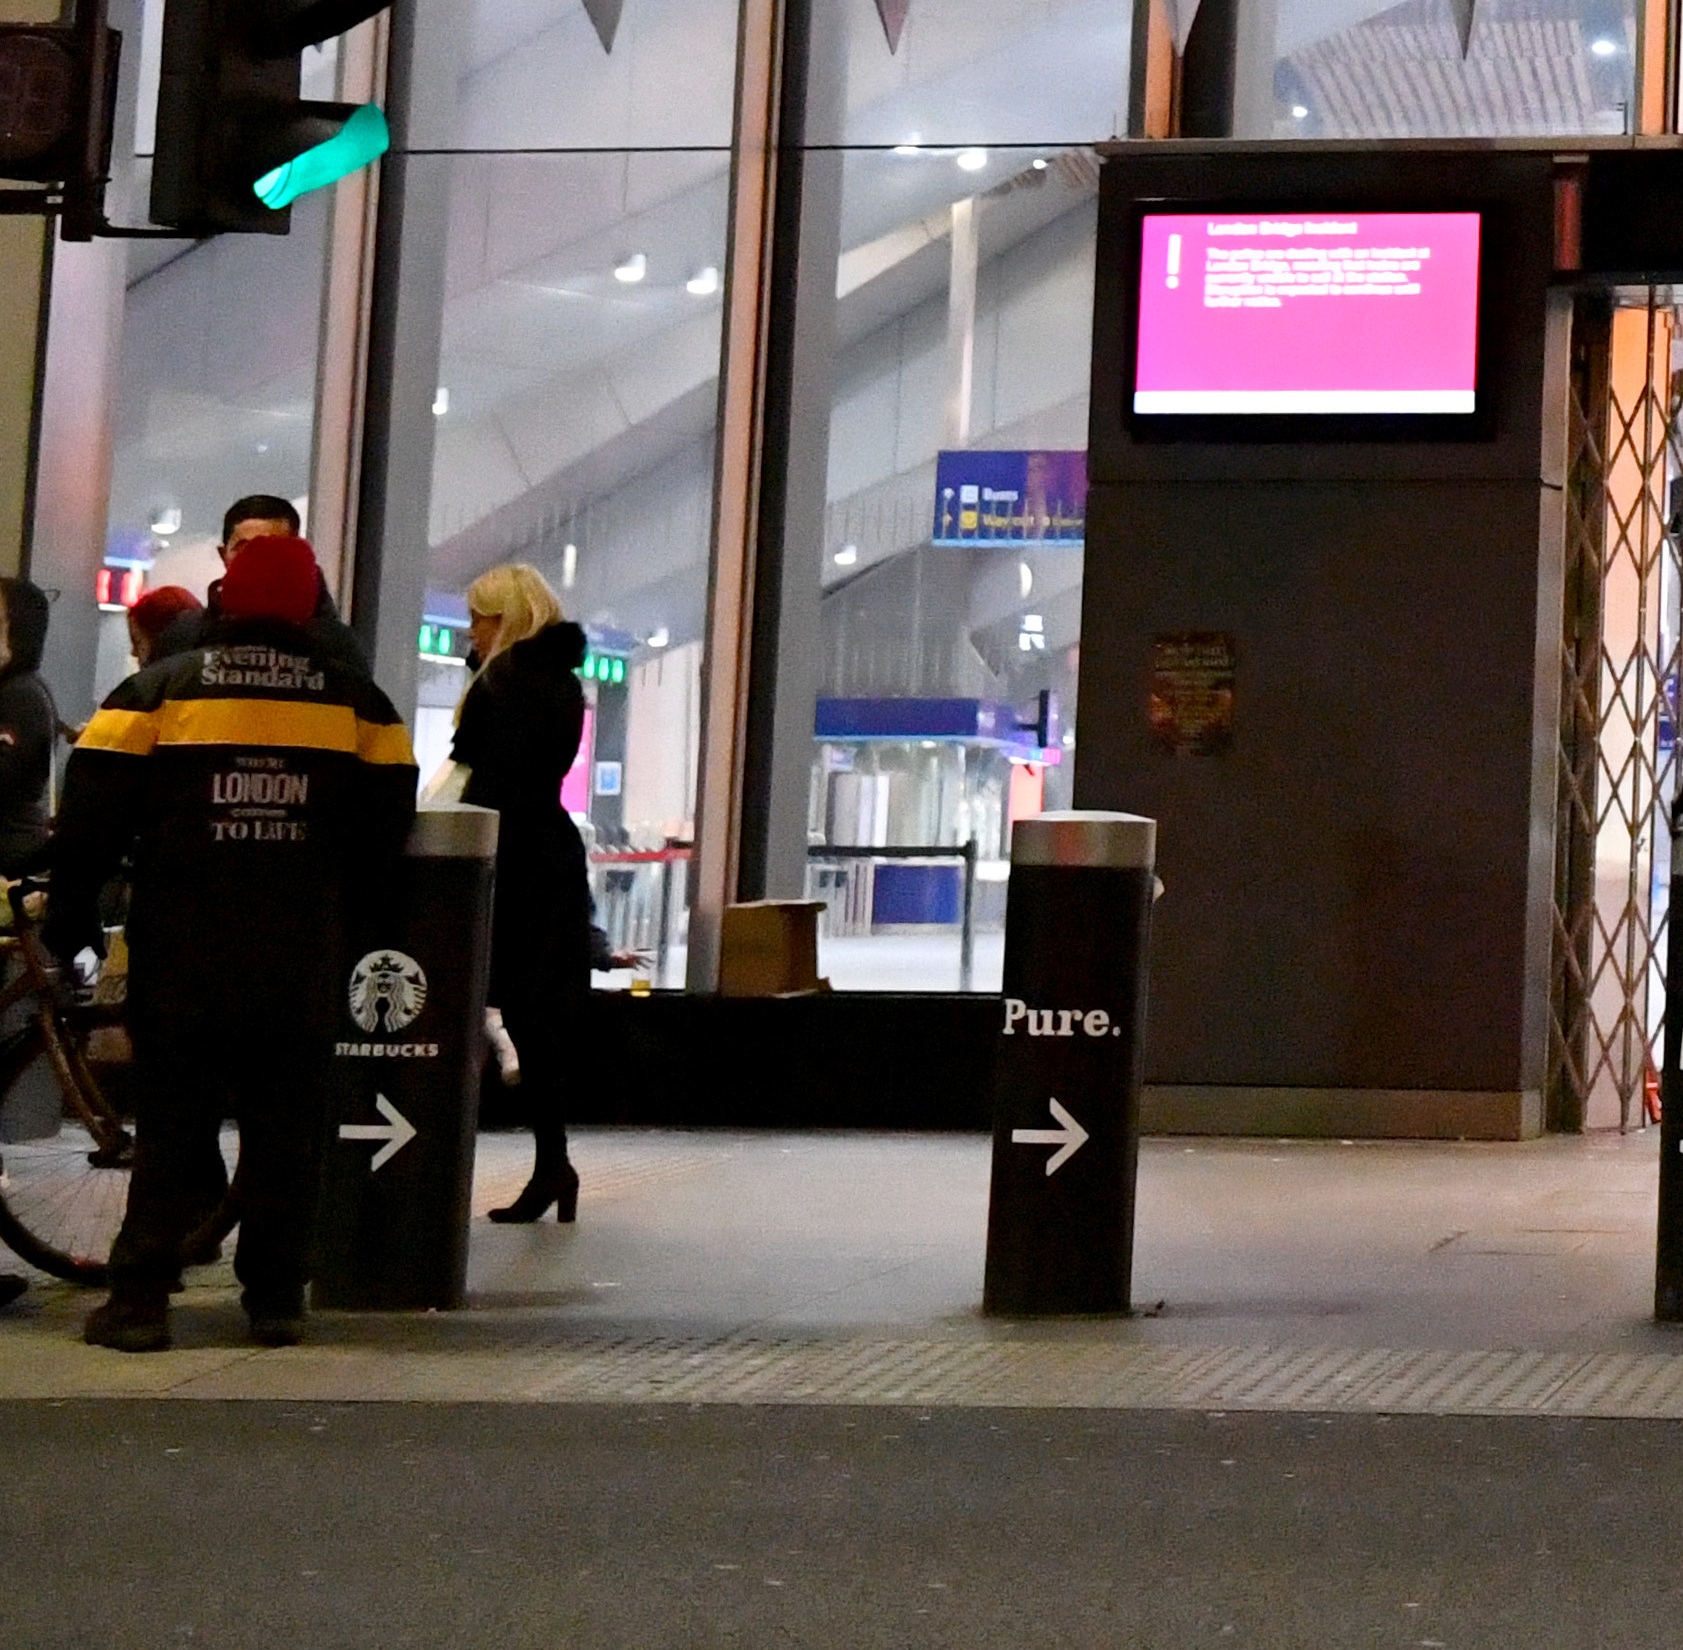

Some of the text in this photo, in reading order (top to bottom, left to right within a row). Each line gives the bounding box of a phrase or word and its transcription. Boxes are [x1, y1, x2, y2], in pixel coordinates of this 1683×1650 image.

[201, 665, 326, 692] Standard
[213, 771, 310, 805] LONDON
[212, 821, 249, 841] TO
[1002, 998, 1121, 1037] Pure.
[335, 1042, 439, 1057] STARBUCKS
